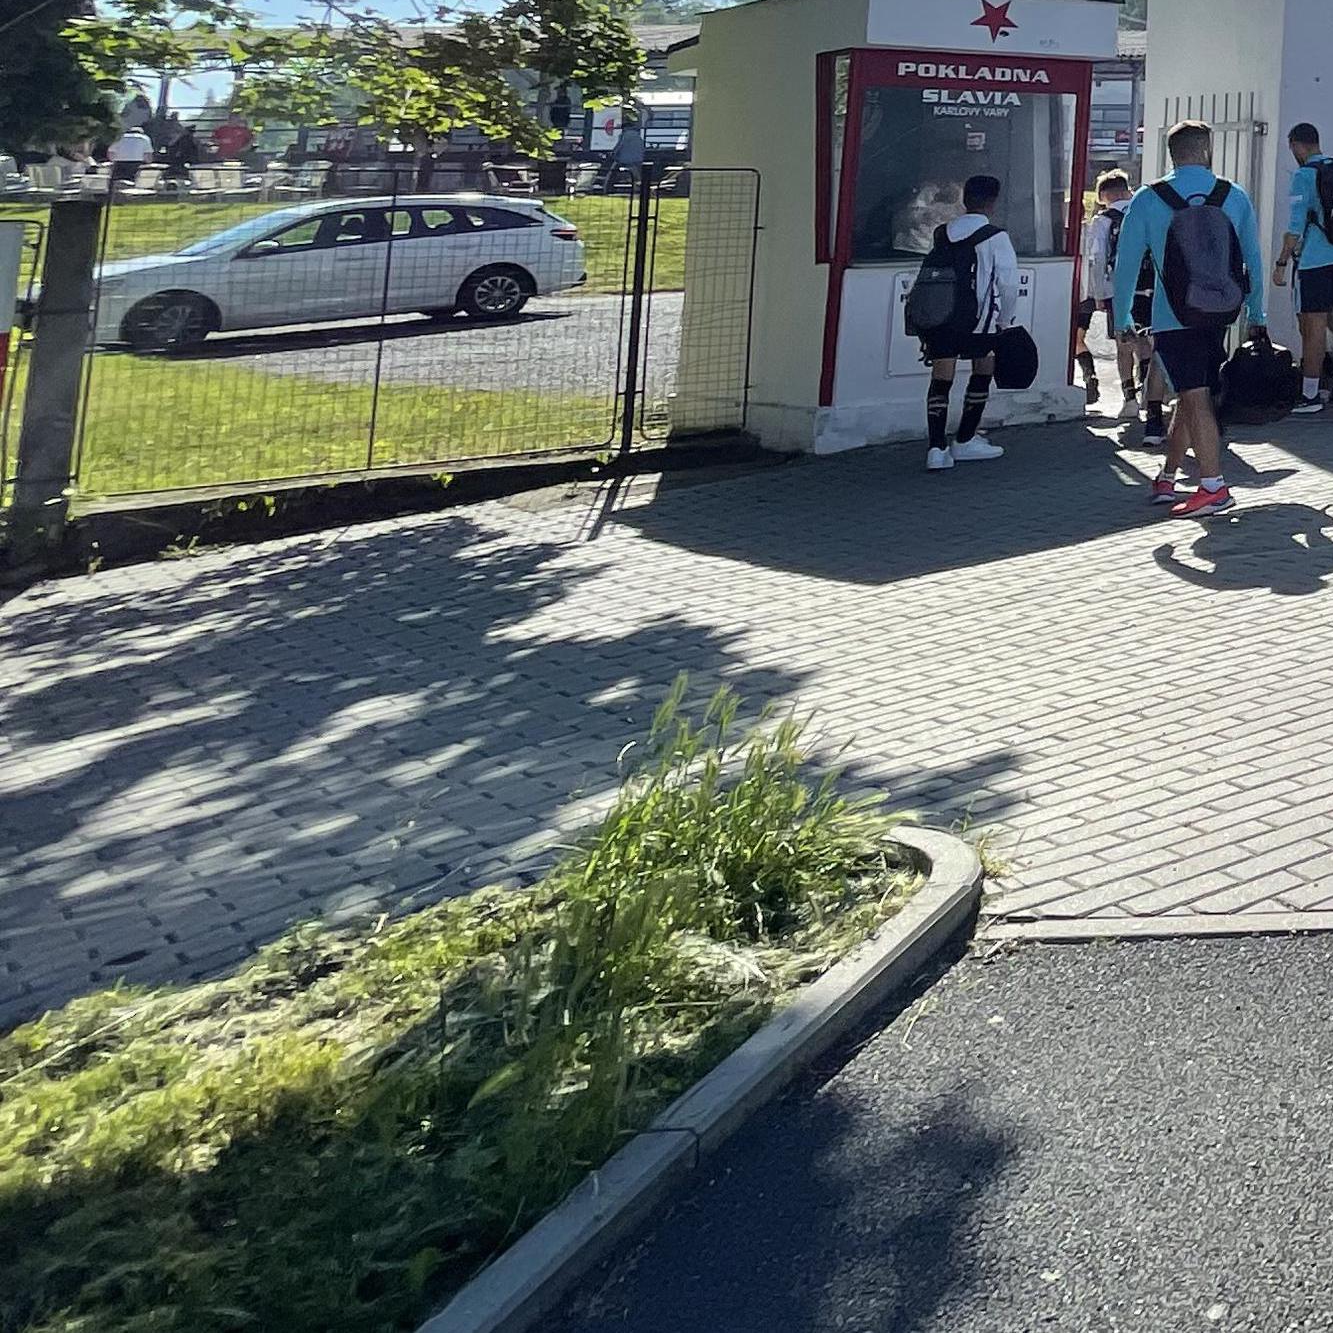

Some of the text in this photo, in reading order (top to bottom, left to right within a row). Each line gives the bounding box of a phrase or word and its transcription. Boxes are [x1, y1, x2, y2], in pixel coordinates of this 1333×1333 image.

[897, 62, 1050, 84] POKLADNA
[922, 88, 1022, 106] SLAVIA
[933, 106, 1010, 117] KARLOVY VARY
